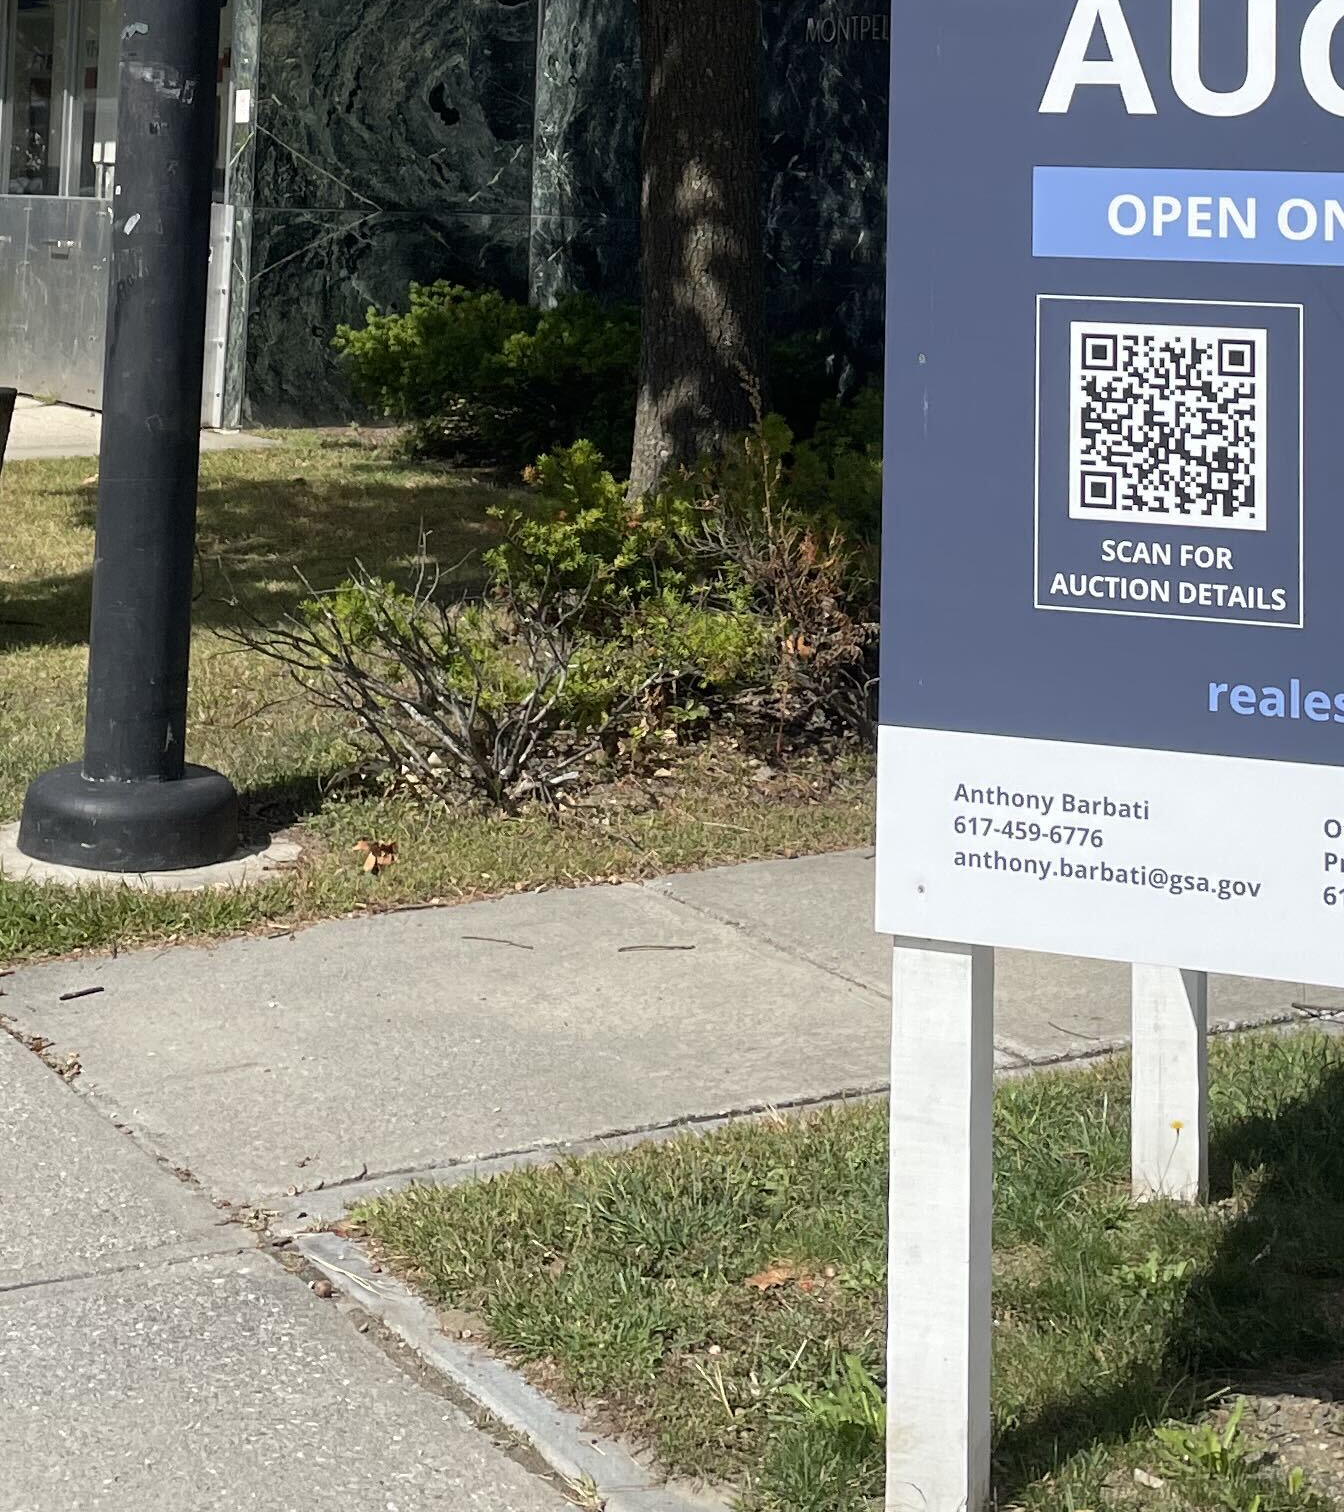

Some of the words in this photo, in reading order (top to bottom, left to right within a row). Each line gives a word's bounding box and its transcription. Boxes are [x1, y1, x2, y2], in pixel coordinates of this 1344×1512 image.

[1107, 193, 1256, 239] OPEN
[1101, 539, 1171, 566] SCAN
[1180, 544, 1234, 570] FOR
[1049, 572, 1170, 603] AUCTION
[1179, 581, 1286, 611] DETAILS
[954, 783, 1054, 816] Anthony
[1062, 793, 1149, 820] Barbati
[954, 815, 1103, 848] 617-459-6776
[953, 850, 1262, 901] anthony.barbati@gsa.gov
